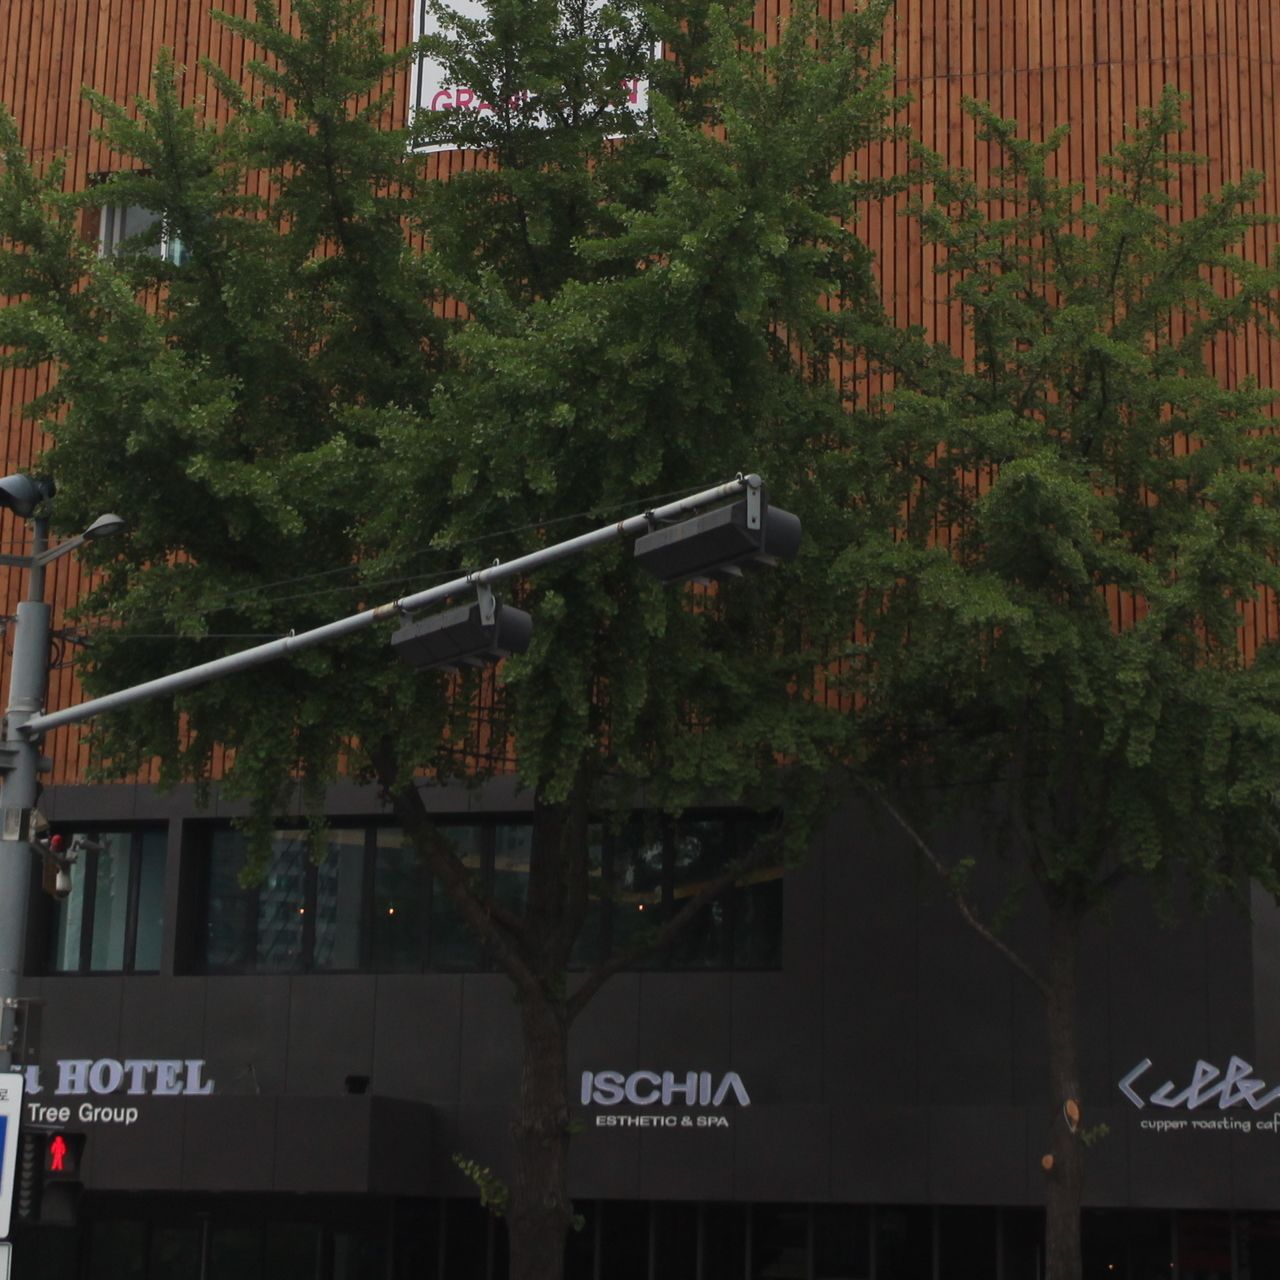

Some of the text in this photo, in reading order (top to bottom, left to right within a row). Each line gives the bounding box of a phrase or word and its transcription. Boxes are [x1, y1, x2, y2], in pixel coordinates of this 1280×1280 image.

[54, 1058, 215, 1095] HOTEL
[580, 1070, 752, 1106] ISCHIA
[28, 1103, 139, 1124] Tree Group
[595, 1115, 729, 1127] ESTHETIC & SPA
[1140, 1119, 1188, 1133] cupper
[1192, 1116, 1251, 1132] roasting
